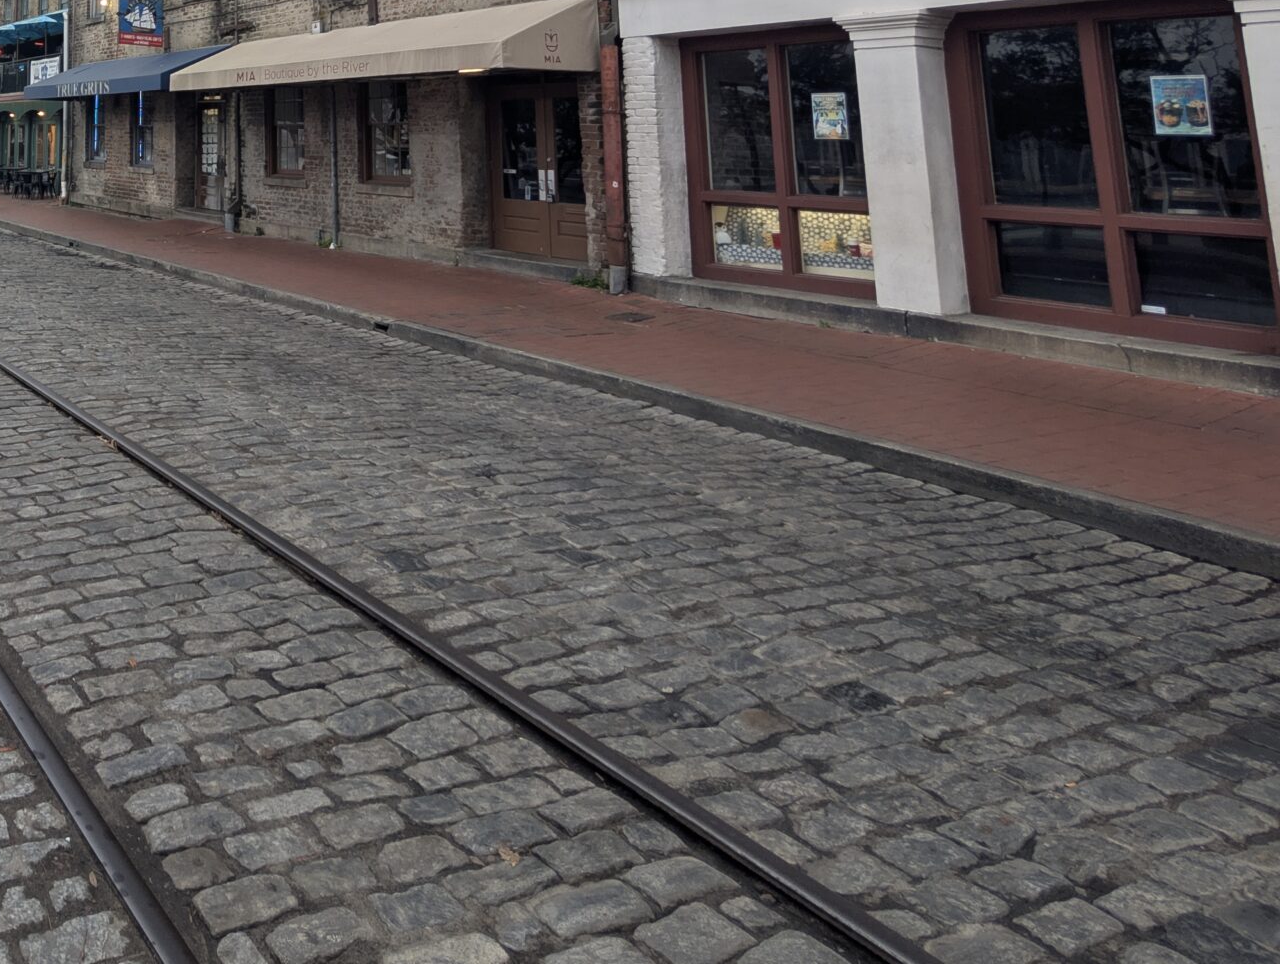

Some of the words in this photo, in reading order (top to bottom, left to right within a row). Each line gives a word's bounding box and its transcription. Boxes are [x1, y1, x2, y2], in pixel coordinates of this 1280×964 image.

[544, 55, 561, 64] MIA
[236, 71, 256, 82] MIA
[264, 68, 305, 80] Boutique
[307, 66, 319, 78] by
[322, 63, 339, 74] the
[342, 60, 370, 73] River
[56, 83, 79, 98] TRUE
[80, 80, 110, 96] GRITS
